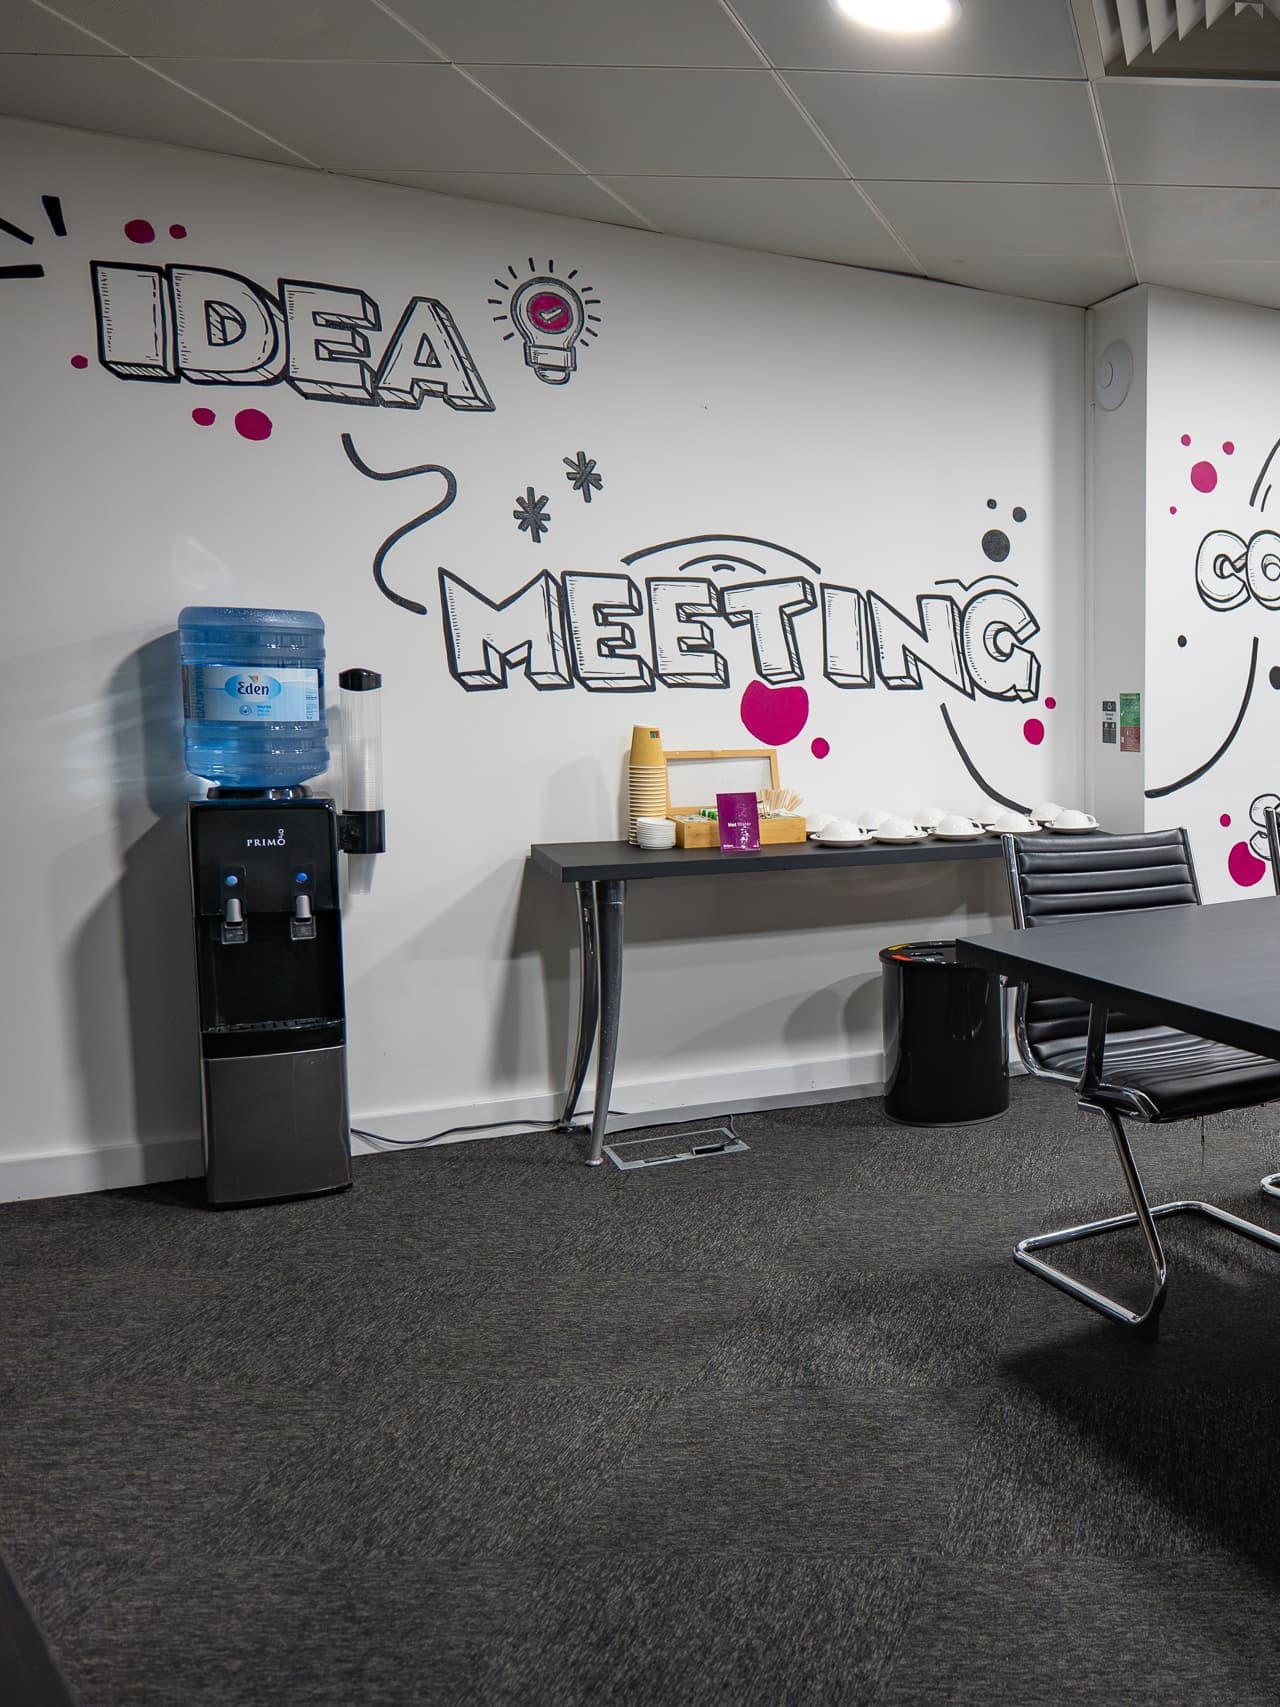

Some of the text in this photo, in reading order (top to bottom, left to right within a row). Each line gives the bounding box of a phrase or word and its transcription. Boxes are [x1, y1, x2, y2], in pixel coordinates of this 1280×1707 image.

[90, 260, 496, 412] IDEA
[438, 566, 1041, 703] MEETING
[237, 681, 270, 696] Eden
[246, 838, 286, 847] PRIMO
